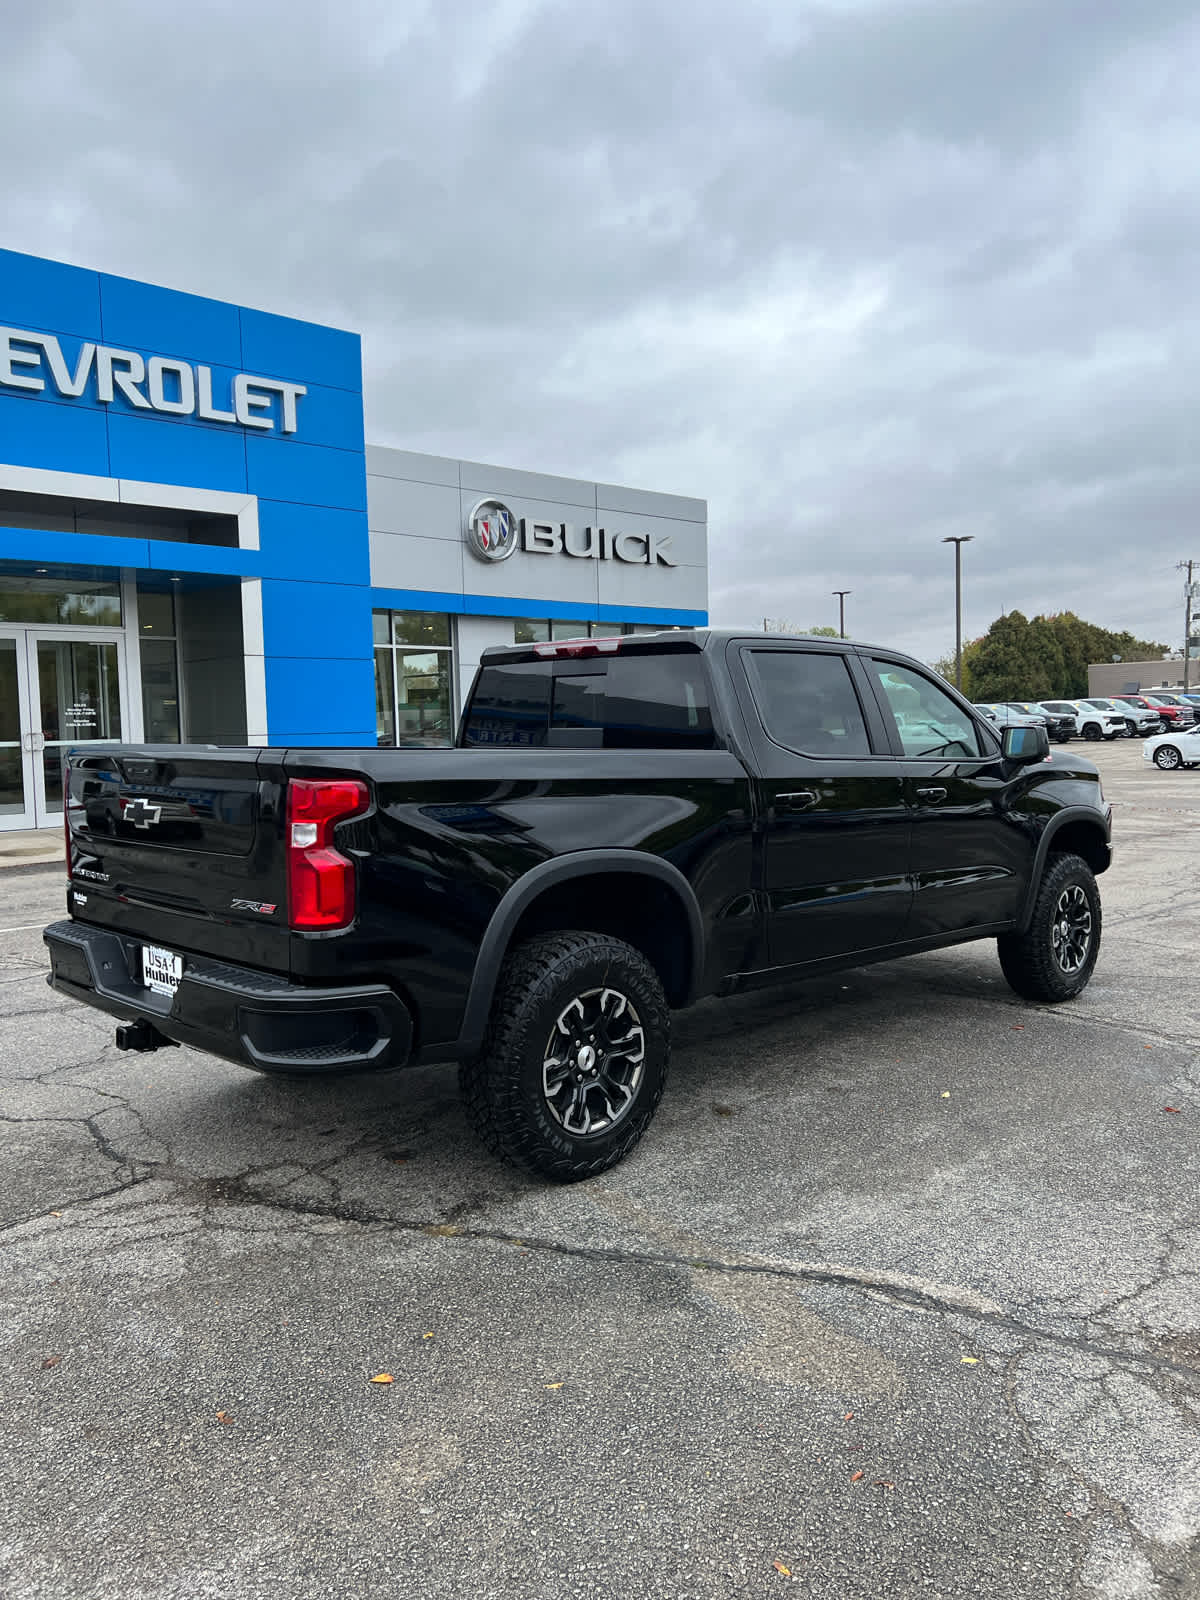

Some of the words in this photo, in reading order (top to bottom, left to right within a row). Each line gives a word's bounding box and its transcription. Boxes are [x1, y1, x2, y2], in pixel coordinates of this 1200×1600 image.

[0, 326, 307, 434] EVROLET
[520, 517, 677, 568] BUICK
[144, 966, 180, 987] Hubler
